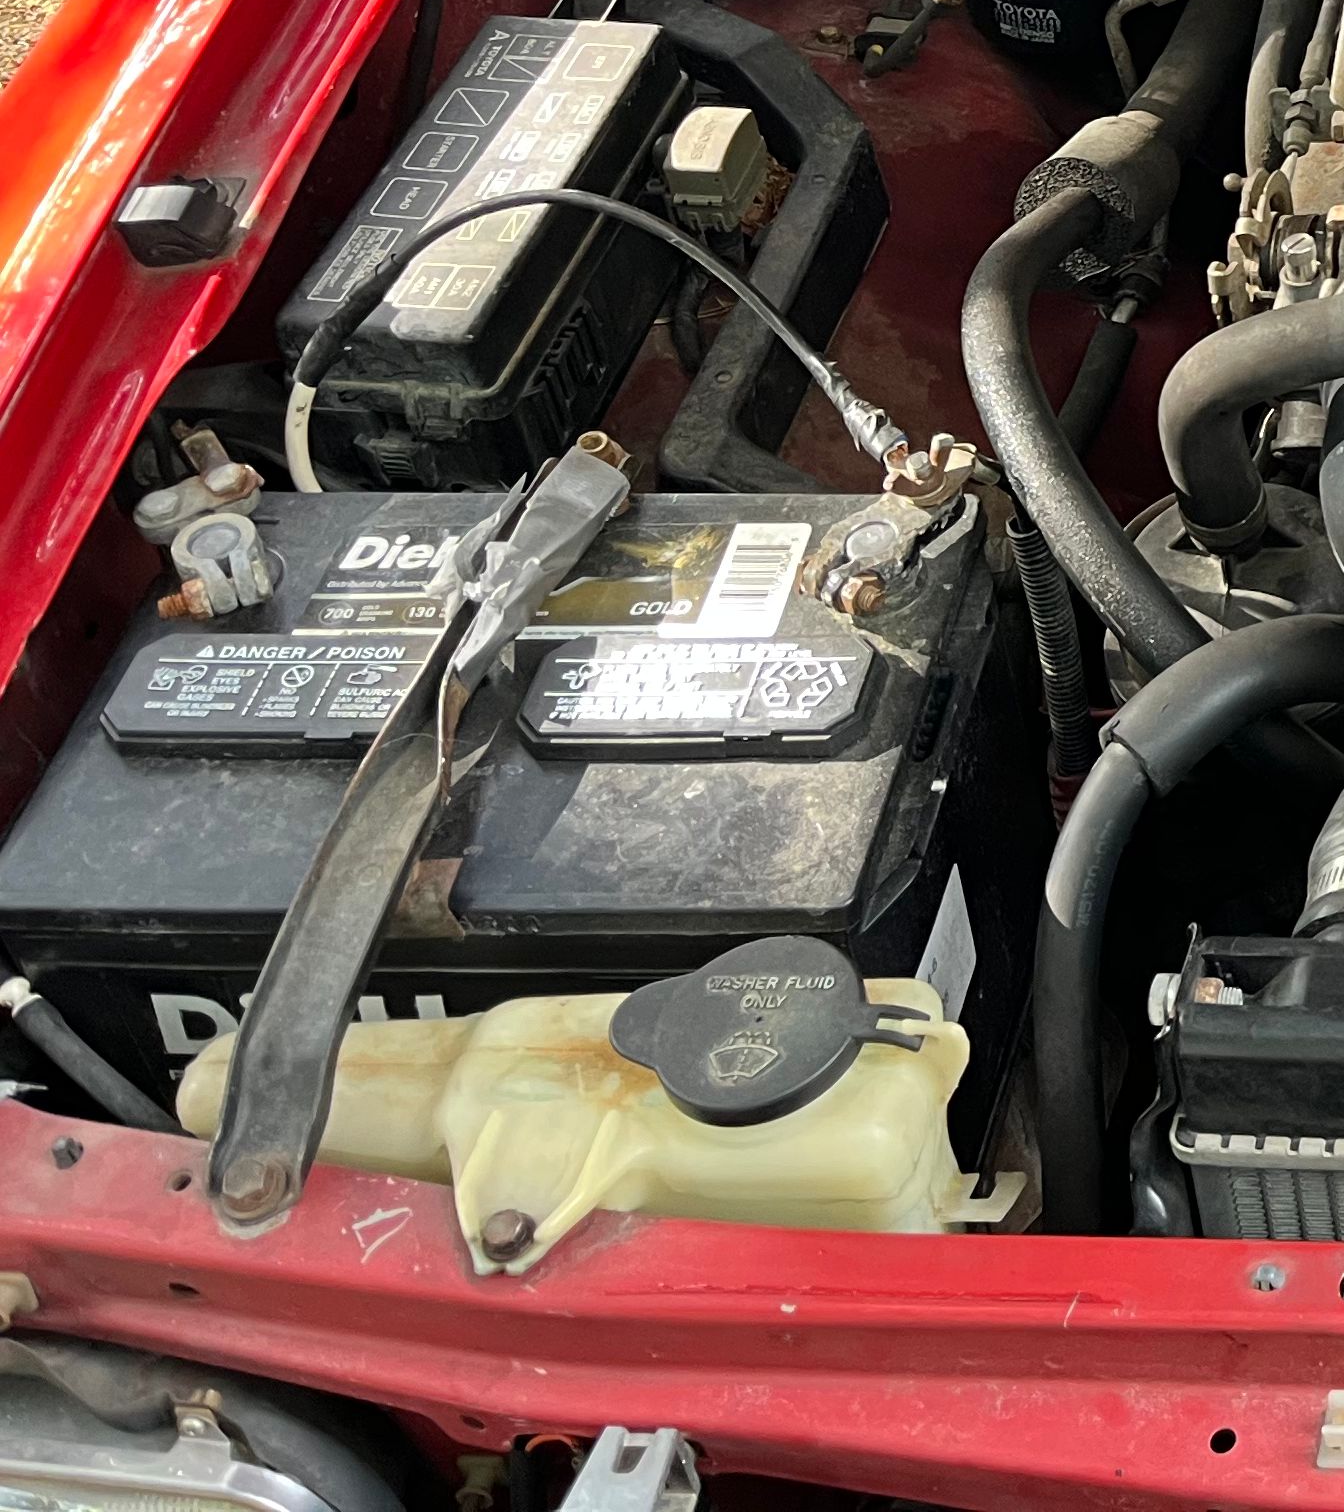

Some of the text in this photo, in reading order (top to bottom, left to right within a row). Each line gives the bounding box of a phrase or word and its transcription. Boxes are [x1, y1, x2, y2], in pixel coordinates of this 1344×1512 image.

[992, 0, 1058, 19] TOYOTA
[474, 45, 503, 77] TOYOTA
[427, 136, 455, 169] STARTER
[399, 186, 422, 210] HEAD
[323, 607, 354, 620] 700
[409, 606, 436, 619] 130
[629, 600, 693, 617] GOLD
[219, 646, 305, 659] DANGER
[326, 646, 406, 659] POISON
[707, 975, 836, 991] WASHER FLUID
[740, 994, 787, 1009] ONLY
